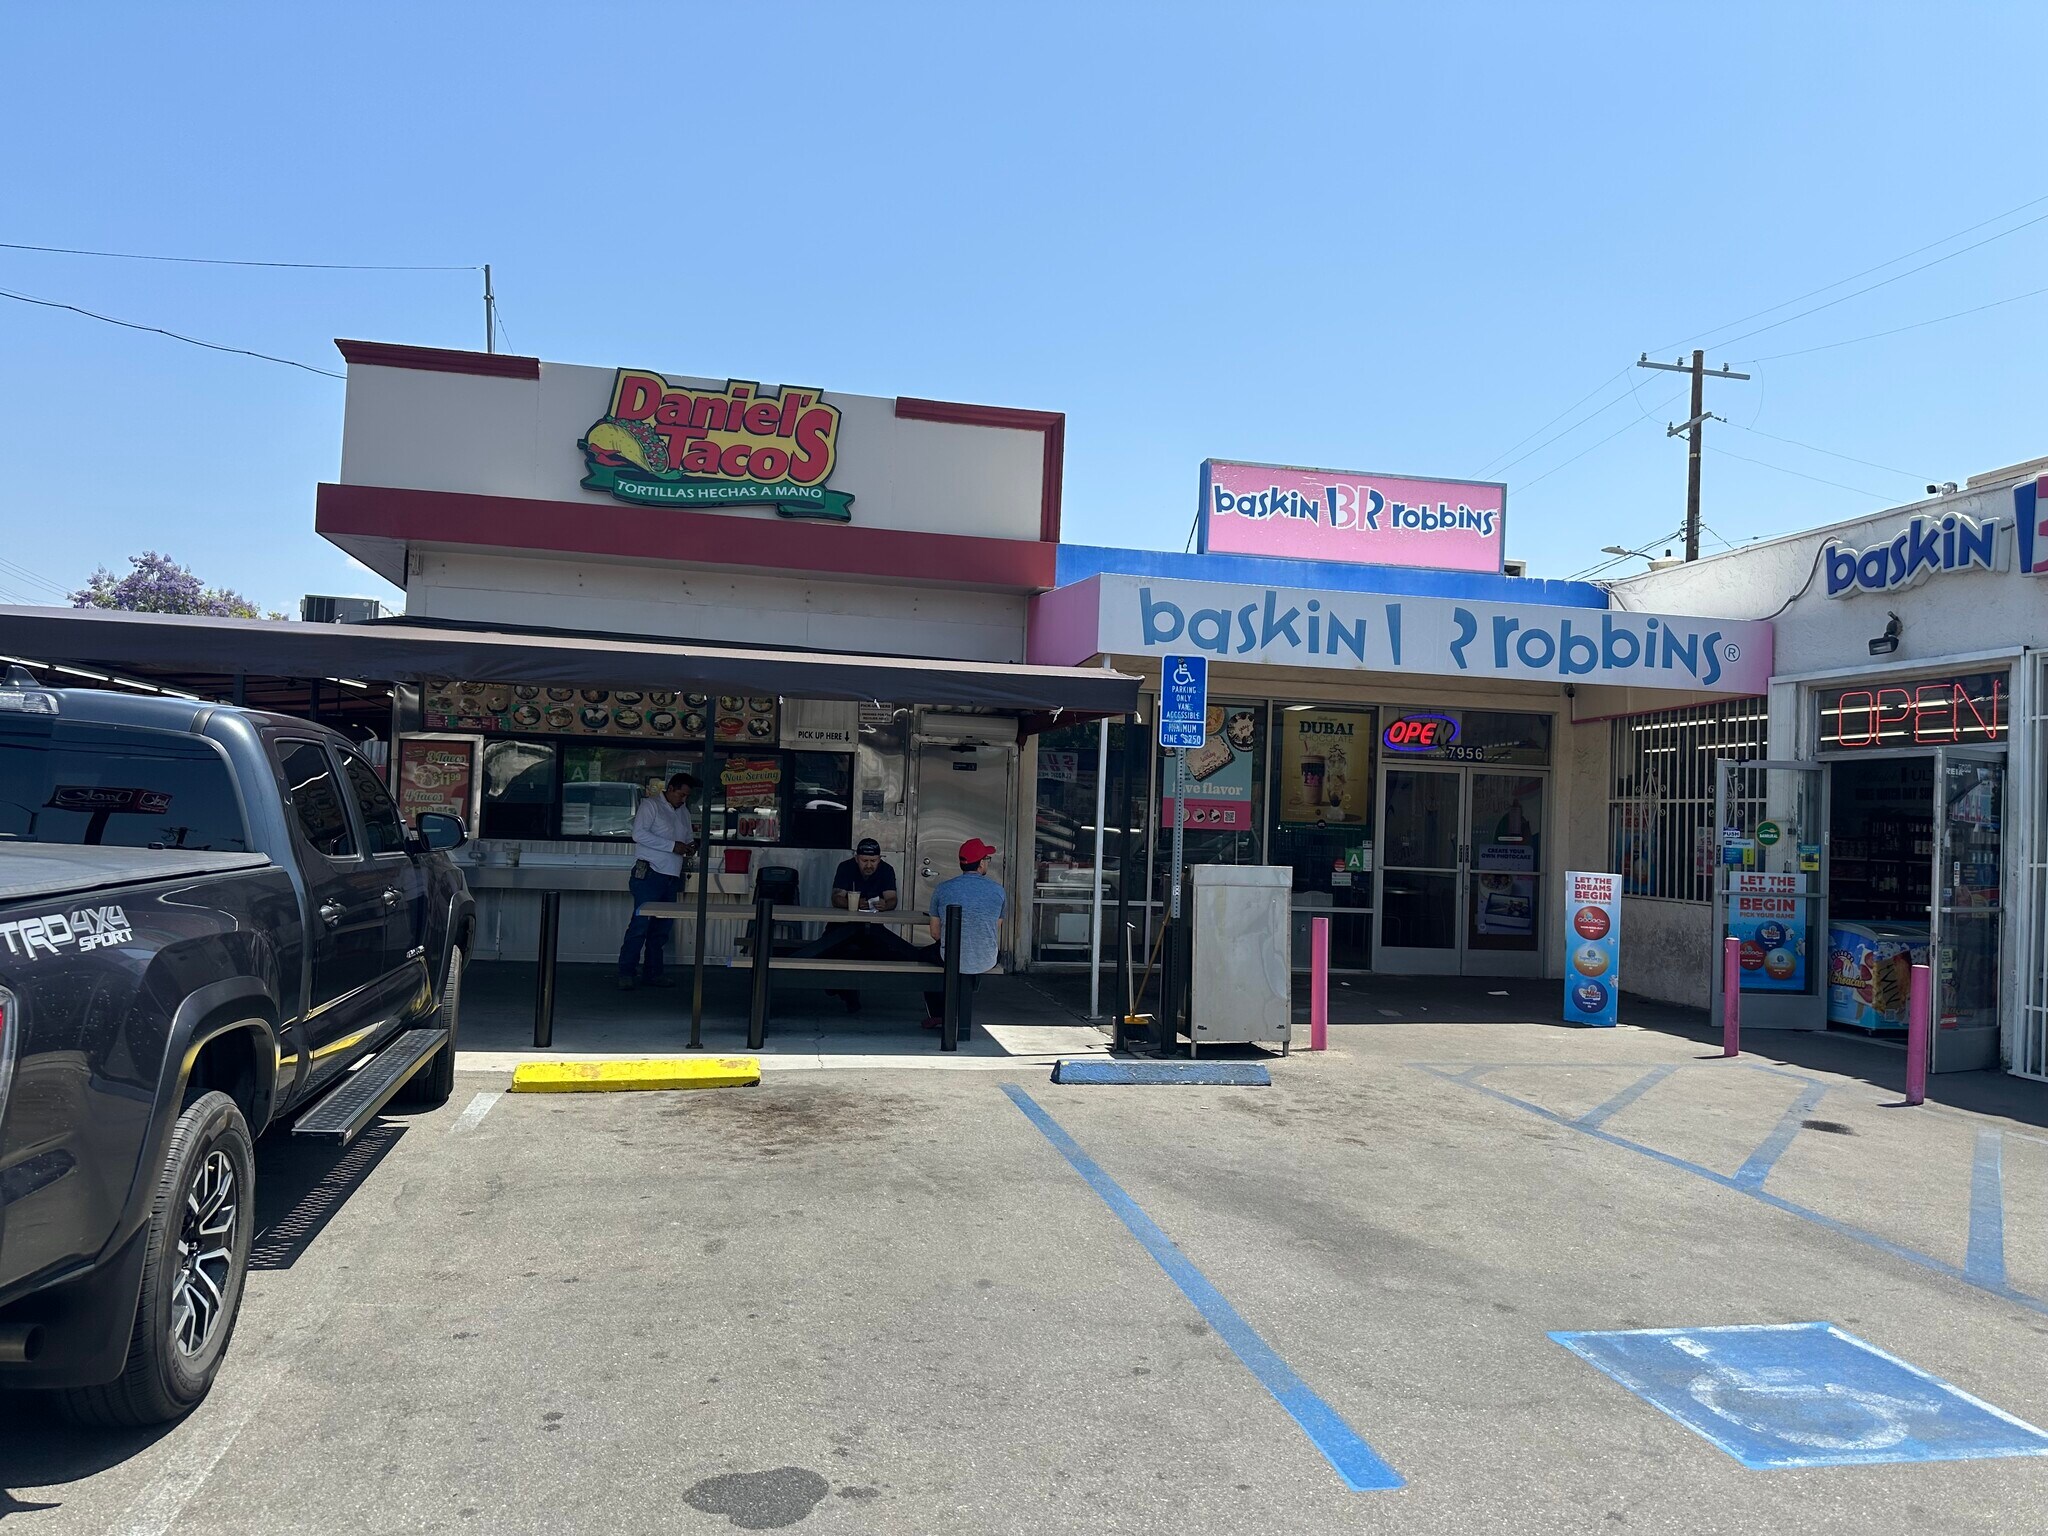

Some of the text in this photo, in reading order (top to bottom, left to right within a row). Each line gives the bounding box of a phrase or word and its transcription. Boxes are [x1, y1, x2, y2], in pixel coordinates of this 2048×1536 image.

[617, 480, 822, 499] TORTILLAS HECHAS A MANO
[1213, 485, 1319, 524] baskin
[1391, 503, 1496, 536] robbins
[1825, 518, 1994, 595] baskin
[1139, 588, 1367, 662] baskin
[1171, 685, 1197, 694] PARKING
[1176, 694, 1192, 702] ONLY
[1166, 711, 1200, 720] ACCESSIBLE
[1838, 680, 1999, 746] OPEN
[1168, 723, 1197, 733] MINIMUM
[1299, 720, 1354, 736] DUBAI
[1388, 721, 1450, 745] OPEN
[798, 730, 842, 740] PICK UP HERE
[1163, 734, 1178, 743] FINE
[1298, 733, 1354, 744] CHOCOLATE
[440, 751, 465, 764] Tacos
[1447, 746, 1484, 760] 7956
[571, 767, 585, 780] A
[723, 769, 779, 783] Now Serving
[1203, 783, 1244, 796] flavor
[415, 791, 443, 804] Tacos
[1348, 853, 1361, 867] A
[1574, 883, 1612, 891] DREAMS
[1593, 877, 1612, 885] THE
[1740, 875, 1796, 887] LET THE
[1574, 891, 1612, 900] BEGIN
[1740, 897, 1796, 912] BEGIN
[70, 905, 131, 934] 4X4
[0, 914, 76, 961] TRD
[79, 928, 133, 952] SPORT
